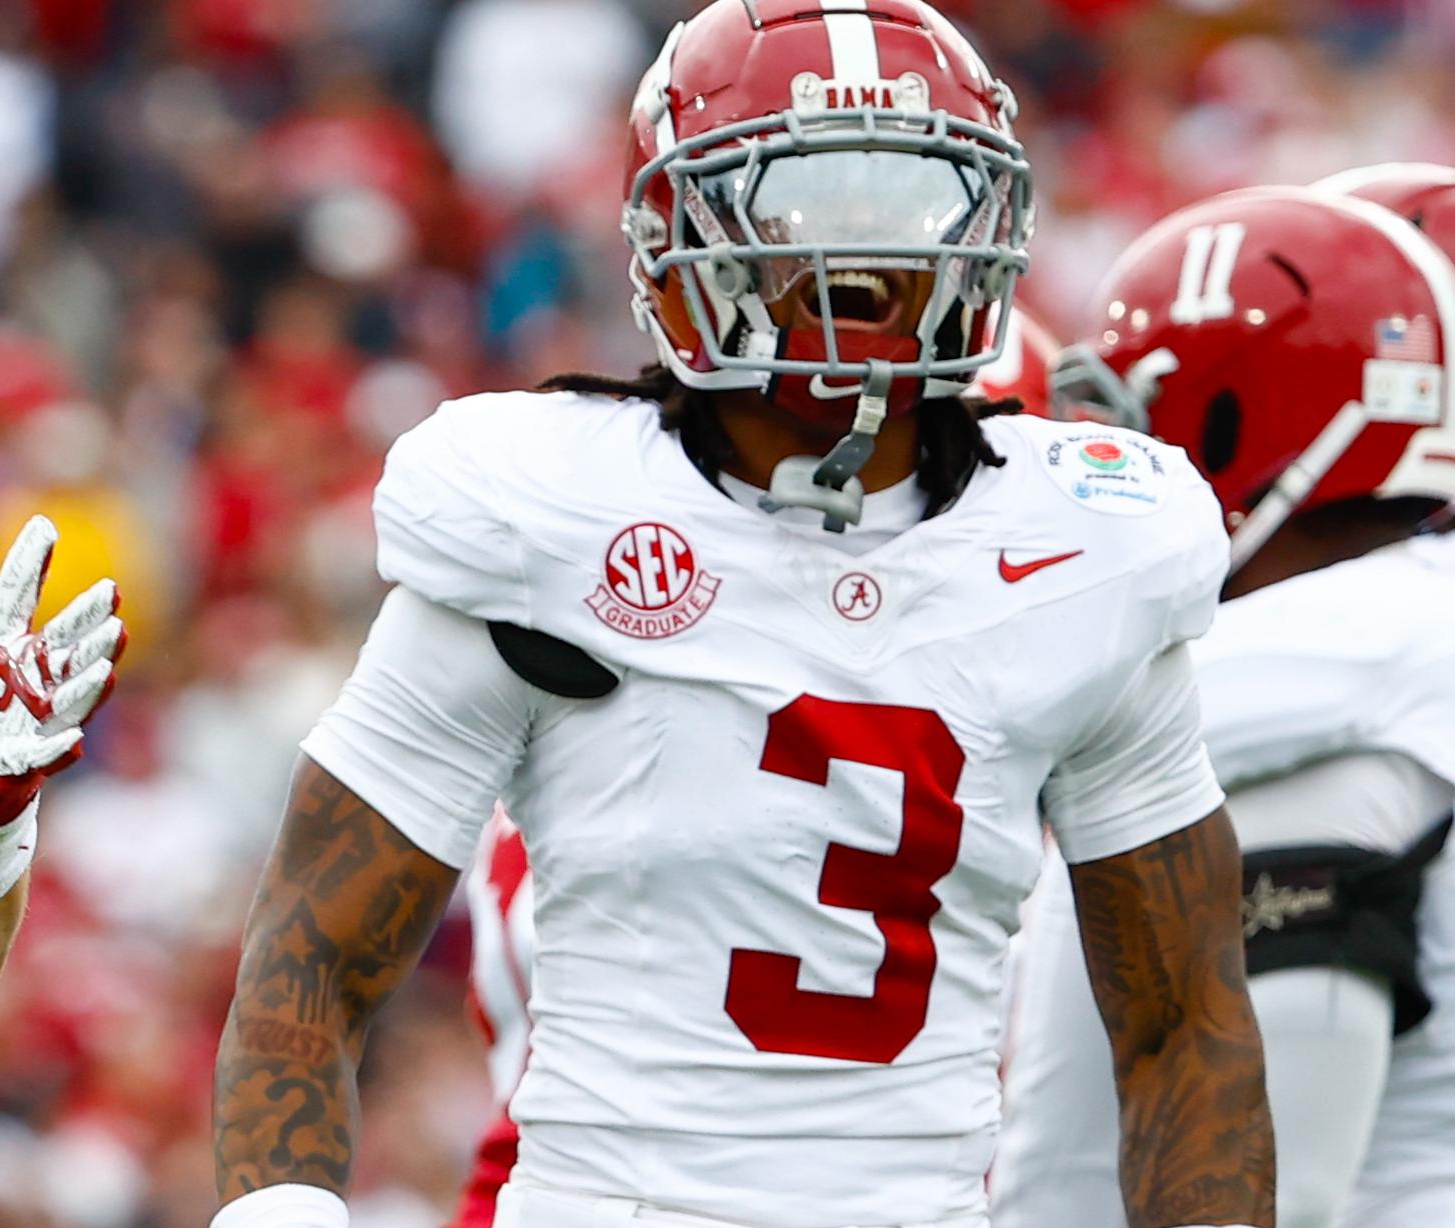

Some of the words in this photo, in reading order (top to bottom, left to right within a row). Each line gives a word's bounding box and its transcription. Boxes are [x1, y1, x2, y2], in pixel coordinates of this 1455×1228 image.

[826, 86, 894, 109] BAMA
[1169, 221, 1246, 325] 11
[608, 525, 692, 608] SEC
[606, 595, 706, 635] GRADUATE
[725, 692, 966, 1065] 3
